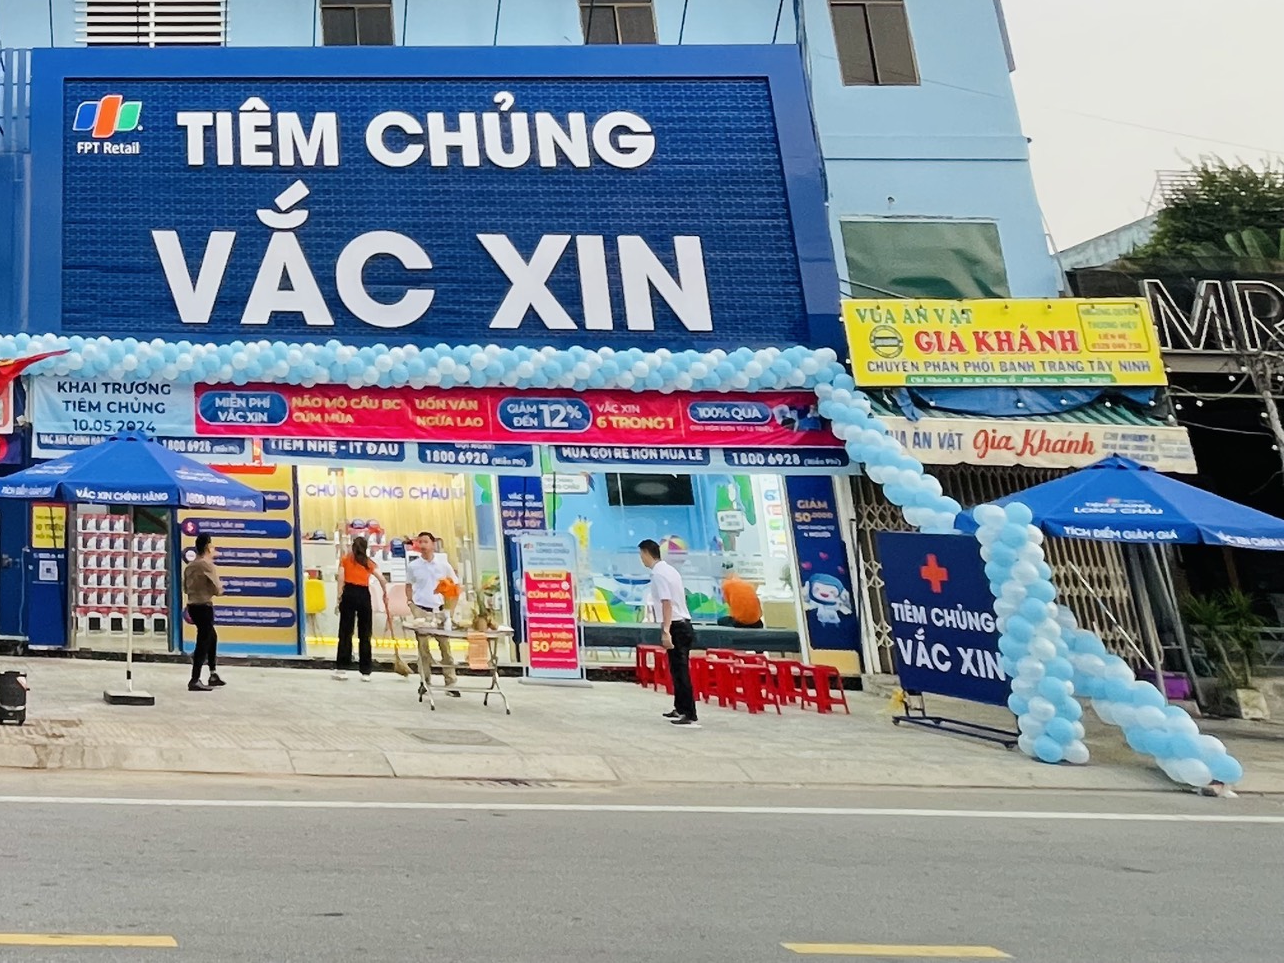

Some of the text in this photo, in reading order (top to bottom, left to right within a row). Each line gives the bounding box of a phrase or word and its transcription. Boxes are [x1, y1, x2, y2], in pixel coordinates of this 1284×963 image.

[177, 90, 656, 169] TIÊM CHỦNG
[77, 141, 140, 154] FPT Retail
[151, 179, 714, 332] VẮC XIN
[914, 330, 969, 355] GIA
[867, 358, 920, 373] CHUYÊN
[1118, 360, 1151, 373] NINH
[57, 380, 171, 395] KHAI TRƯƠNG
[62, 396, 166, 415] TIÊM CHỦNG
[248, 396, 271, 408] PHÍ
[381, 398, 402, 410] BC
[507, 401, 537, 414] GIẢM
[596, 401, 640, 414] VẮC XIN
[217, 408, 268, 422] VẮC XIN
[513, 414, 538, 427] ĐẾN
[696, 405, 763, 421] 100% QUÀ
[72, 418, 156, 433] 10.05.2024
[457, 416, 484, 427] LAO
[596, 416, 674, 430] 6 TRONG 1
[187, 440, 211, 453] 6928
[307, 441, 337, 456] NHẸ
[366, 442, 399, 456] ĐAU
[972, 428, 1016, 459] Gia
[1015, 428, 1096, 458] Khánh
[425, 450, 456, 463] 1800
[458, 451, 489, 465] 6928
[562, 446, 589, 459] MUA
[659, 448, 688, 461] MUA
[732, 451, 765, 465] 1800
[767, 452, 801, 466] 6928
[76, 486, 96, 499] VẮC
[97, 491, 112, 500] XIN
[113, 490, 141, 502] CHÍNH
[363, 483, 450, 500] LONG CHÂU
[1073, 506, 1116, 514] LONG
[1064, 525, 1091, 538] TÍCH
[1156, 528, 1178, 540] GIÁ
[890, 598, 996, 633] TIÊM CHỦNG
[896, 627, 1007, 682] VẮC XIN
